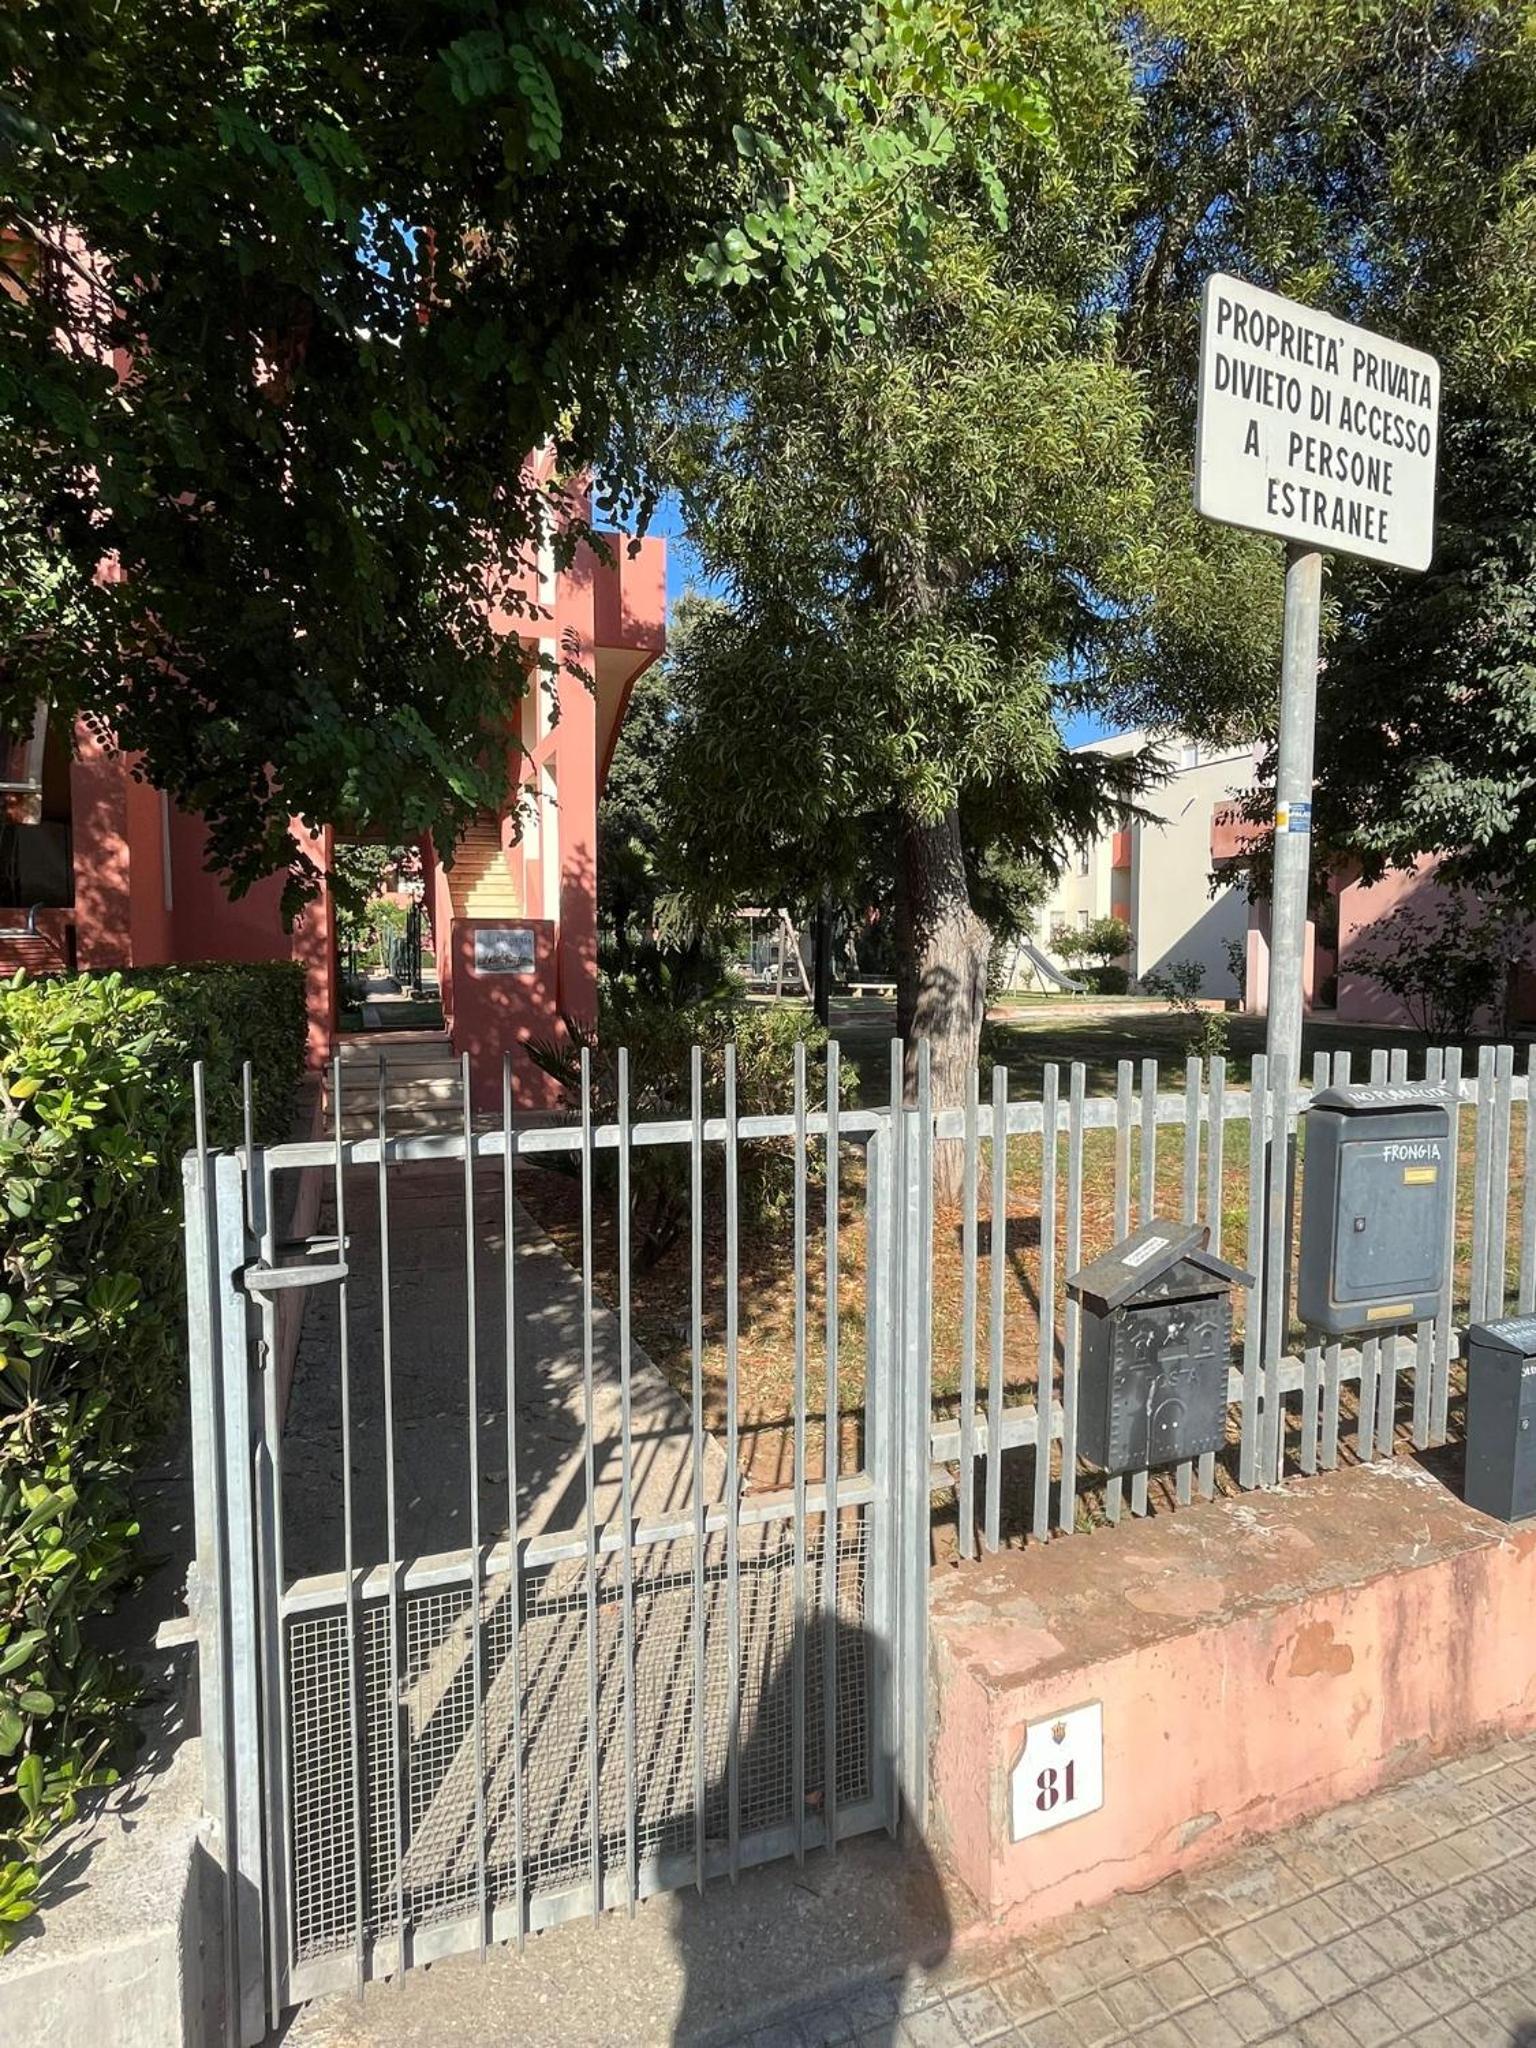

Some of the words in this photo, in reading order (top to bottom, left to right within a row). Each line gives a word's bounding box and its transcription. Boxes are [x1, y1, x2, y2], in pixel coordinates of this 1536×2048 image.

[1217, 297, 1344, 374] PROPRIETA'
[1353, 348, 1432, 409] PRIVATA
[1215, 353, 1301, 414] DIVIETO
[1311, 385, 1332, 425] DI
[1339, 397, 1431, 457] ACCESSO
[1245, 420, 1260, 457] A
[1289, 432, 1393, 496] PERSONE
[1267, 478, 1388, 544] ESTRANEE
[1383, 1144, 1441, 1162] FRONGIA
[1036, 1759, 1077, 1811] 81
